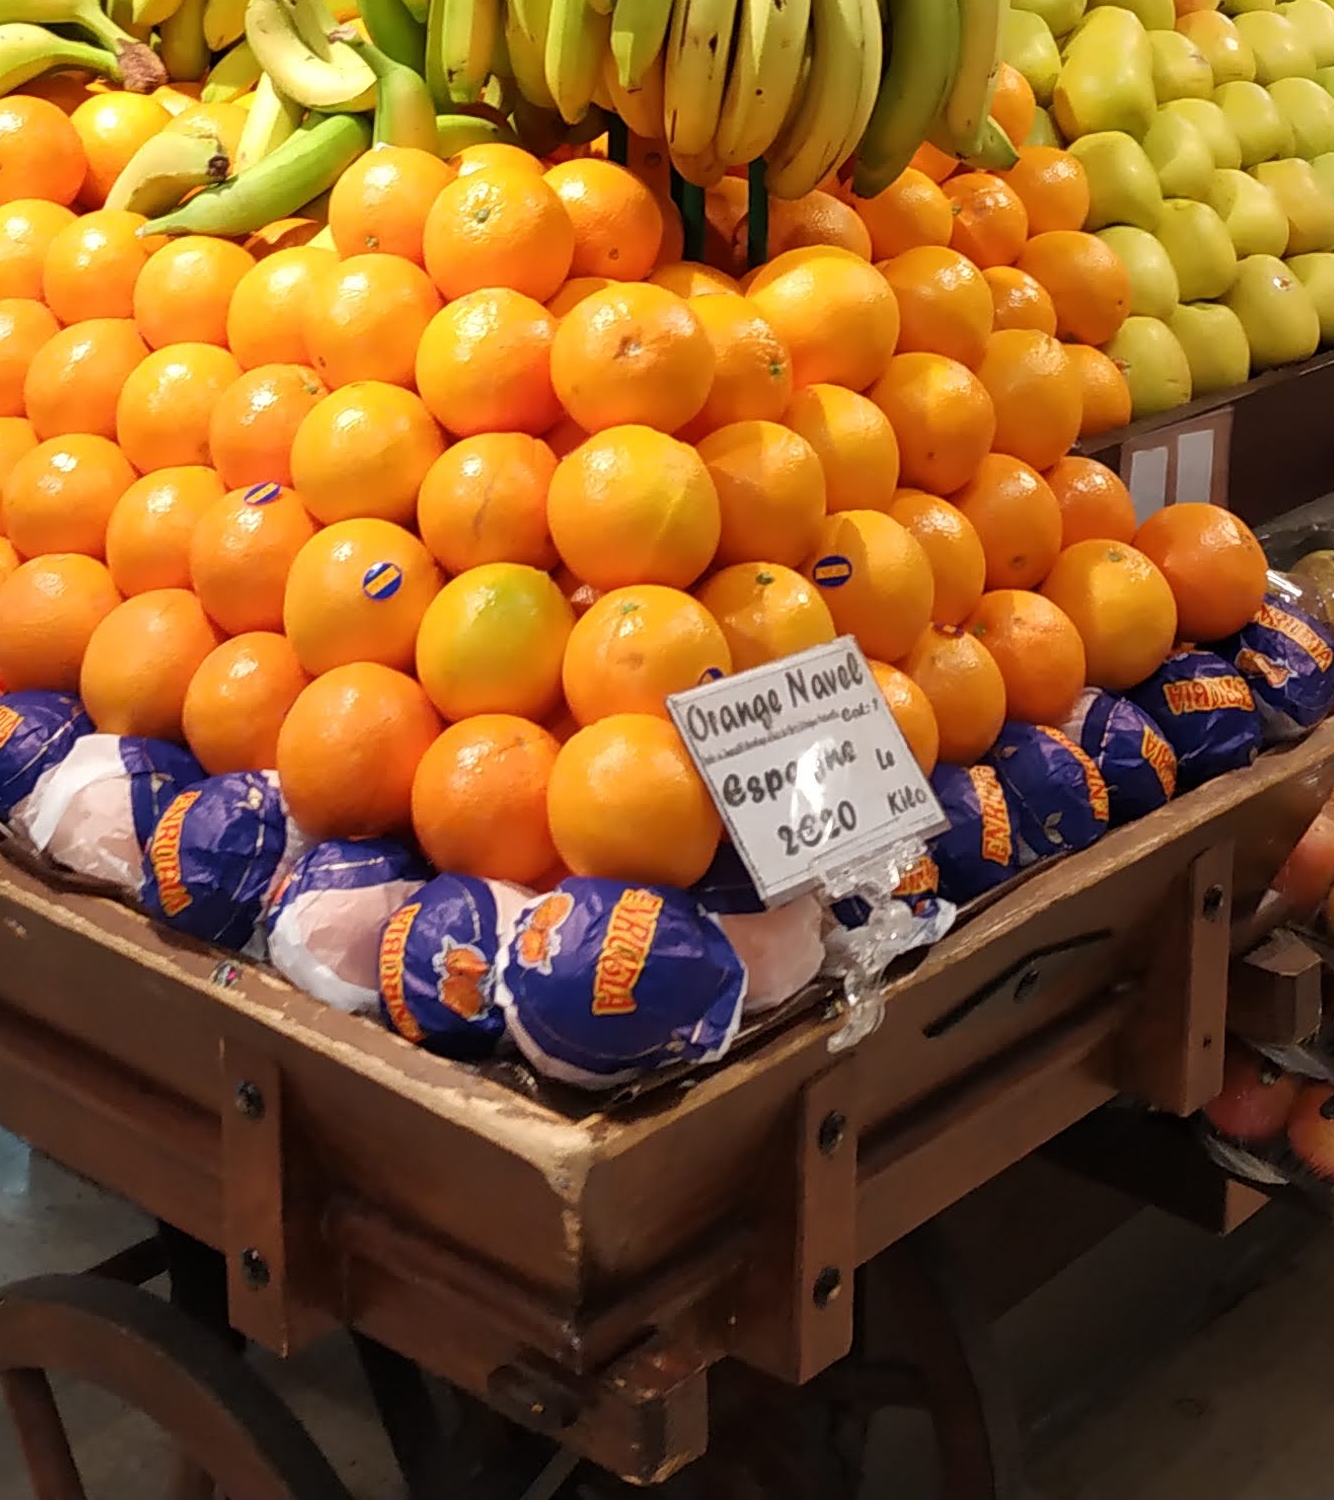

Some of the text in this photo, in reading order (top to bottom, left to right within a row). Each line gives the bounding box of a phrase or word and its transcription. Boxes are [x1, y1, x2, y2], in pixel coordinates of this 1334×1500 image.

[687, 690, 782, 741] Orange
[786, 652, 863, 708] Navel
[876, 748, 895, 771] Le
[887, 786, 927, 817] Kilo
